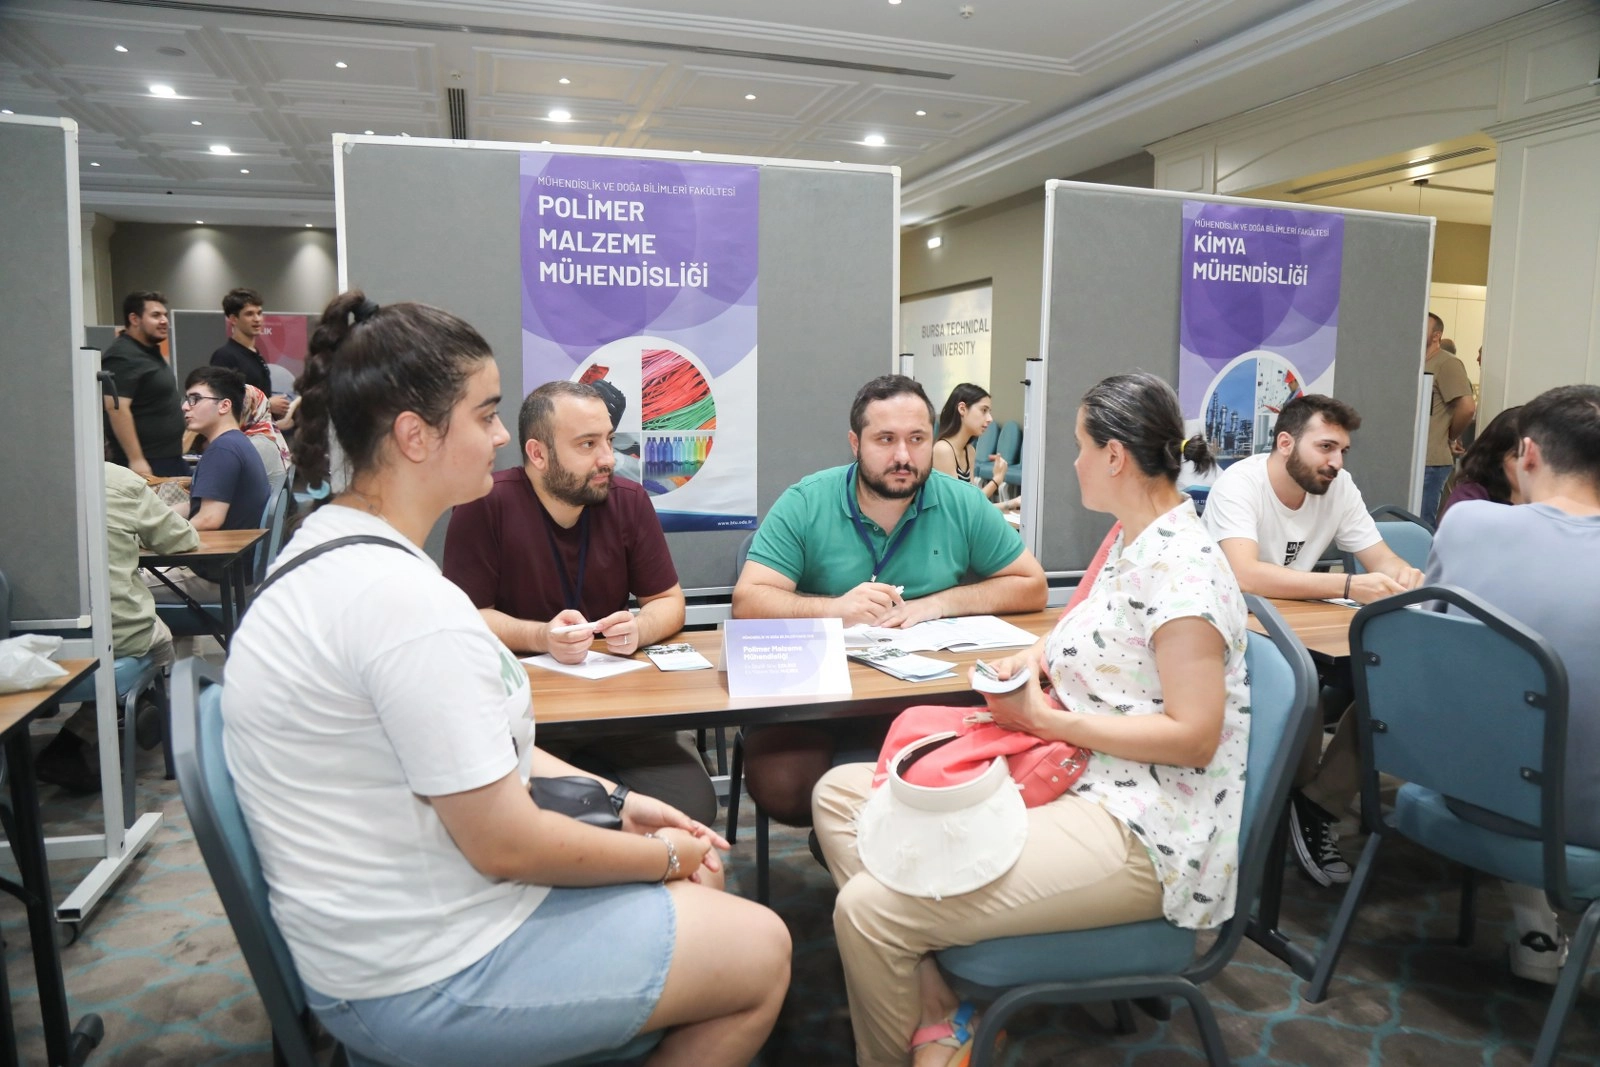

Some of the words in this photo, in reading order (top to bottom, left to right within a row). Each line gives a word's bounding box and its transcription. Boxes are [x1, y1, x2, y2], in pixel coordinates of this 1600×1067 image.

[603, 182, 615, 191] VE
[643, 182, 688, 195] BİLİMLERİ
[689, 183, 736, 197] FAKÜLTESİ
[538, 193, 645, 222] POLİMER
[1240, 223, 1248, 231] VE
[539, 228, 656, 255] MALZEME
[1194, 230, 1246, 255] KİMYA
[539, 257, 708, 288] MÜHENDİSLİĞİ
[1192, 258, 1308, 286] MÜHENDİSLİĞİ
[921, 323, 945, 339] BURSA
[946, 318, 990, 336] TECHNICAL
[932, 340, 976, 357] UNIVERSITY
